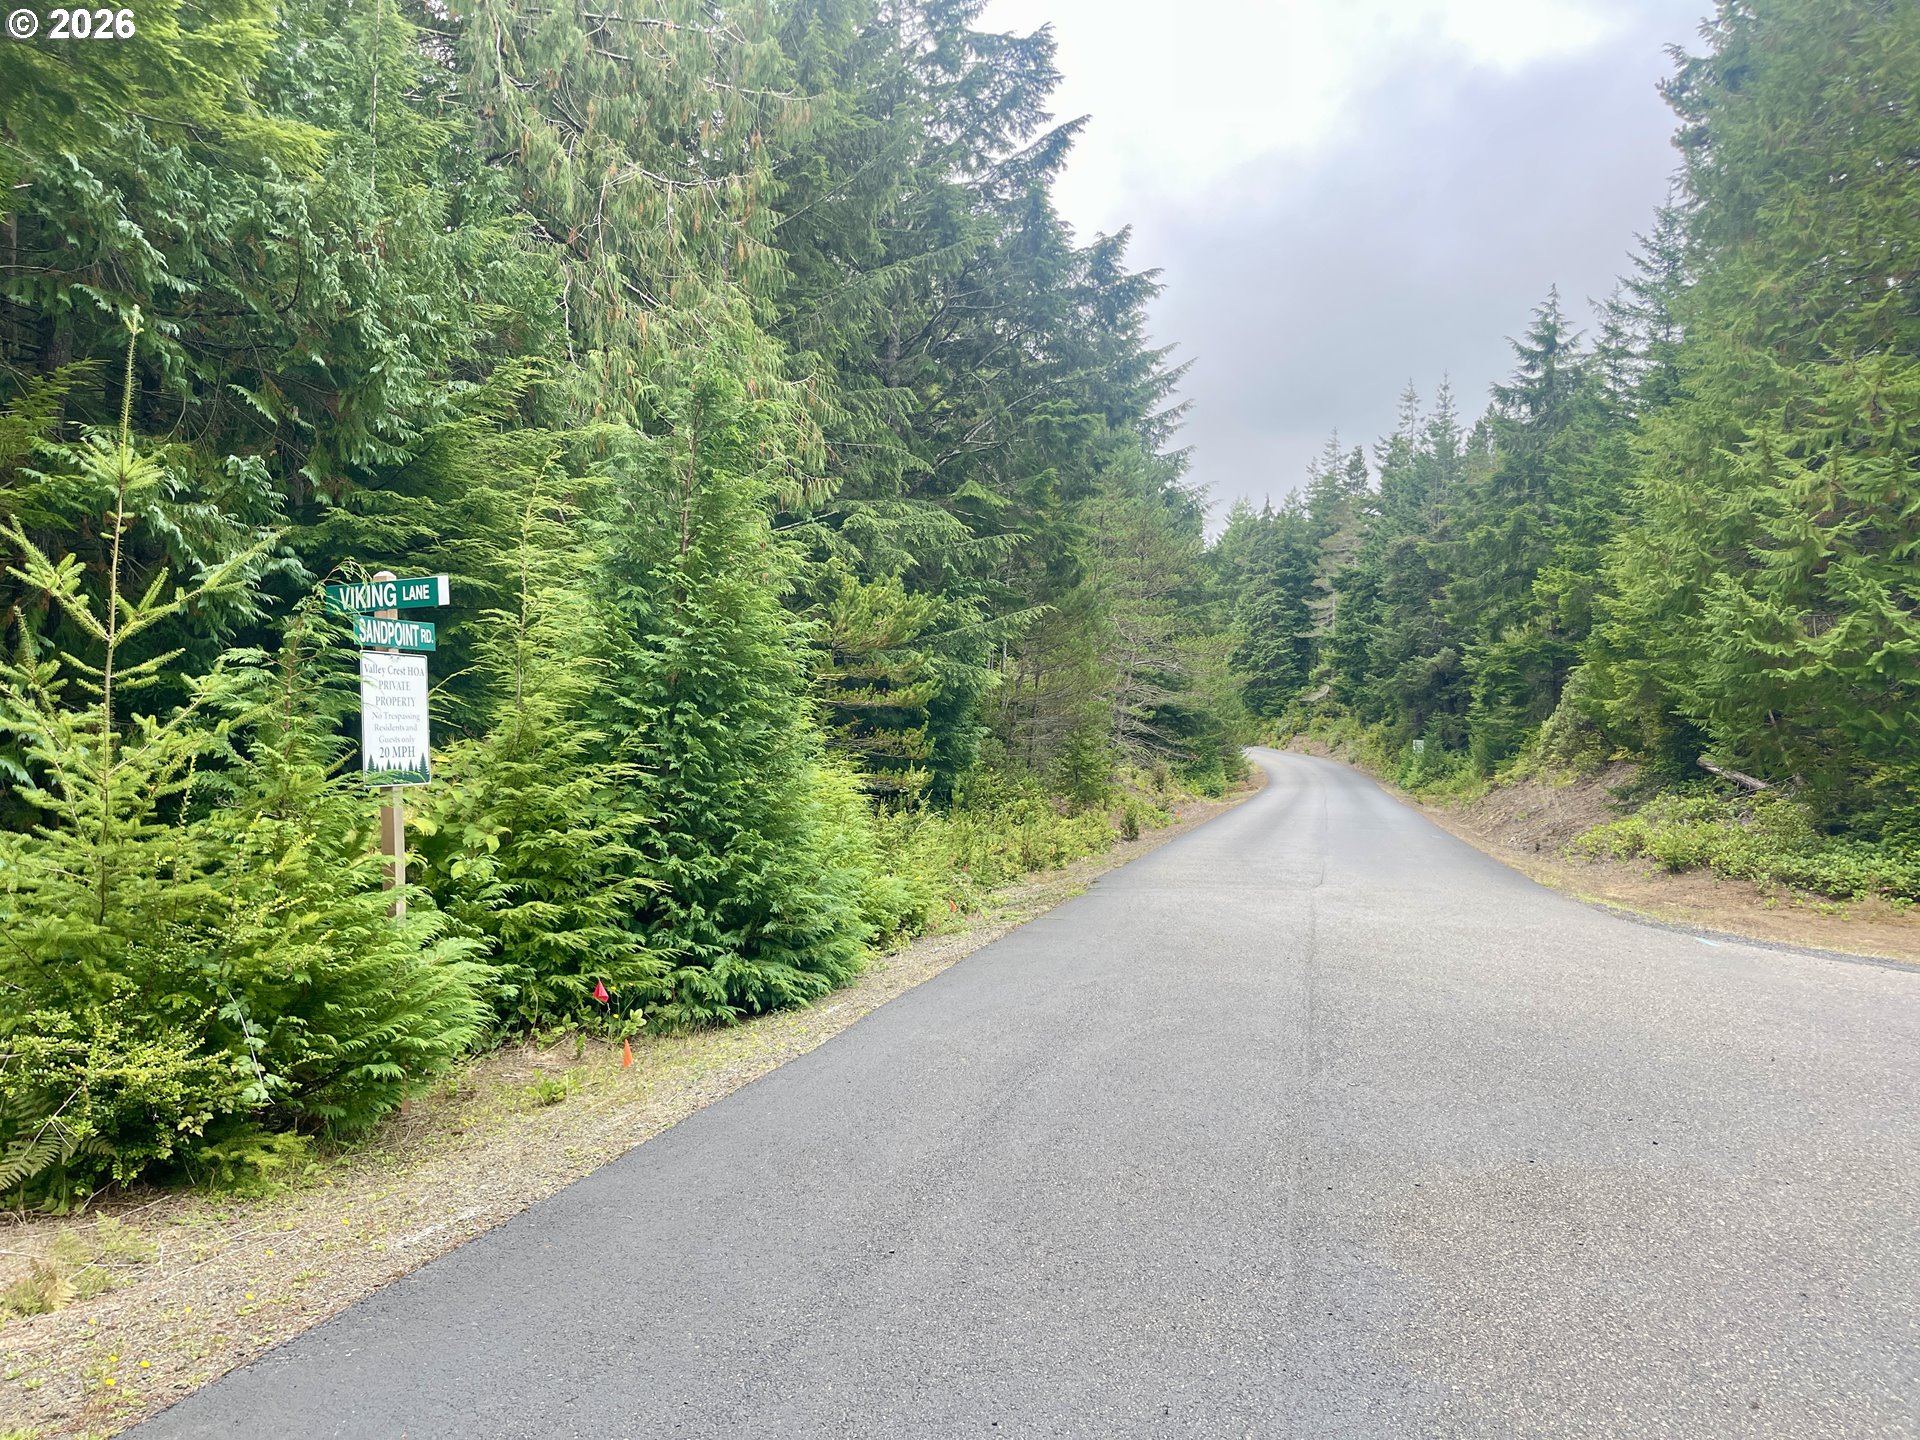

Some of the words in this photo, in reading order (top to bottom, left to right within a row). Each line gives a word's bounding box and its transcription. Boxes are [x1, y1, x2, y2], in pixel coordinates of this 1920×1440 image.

[339, 583, 397, 610] VIKING
[402, 584, 430, 601] LANE
[359, 618, 420, 647] SANDPOINT
[364, 663, 386, 676] Valley
[387, 665, 406, 676] Crest
[407, 666, 425, 677] HOA
[378, 680, 411, 691] PRIVATE
[375, 696, 416, 707] PROPERTY
[372, 711, 383, 720] No
[384, 711, 421, 722] Trespassing
[374, 723, 405, 732] Residents
[405, 723, 418, 732] and
[378, 735, 401, 744] Guests
[401, 735, 415, 744] only
[379, 746, 390, 758] 20
[392, 746, 416, 758] MPH
